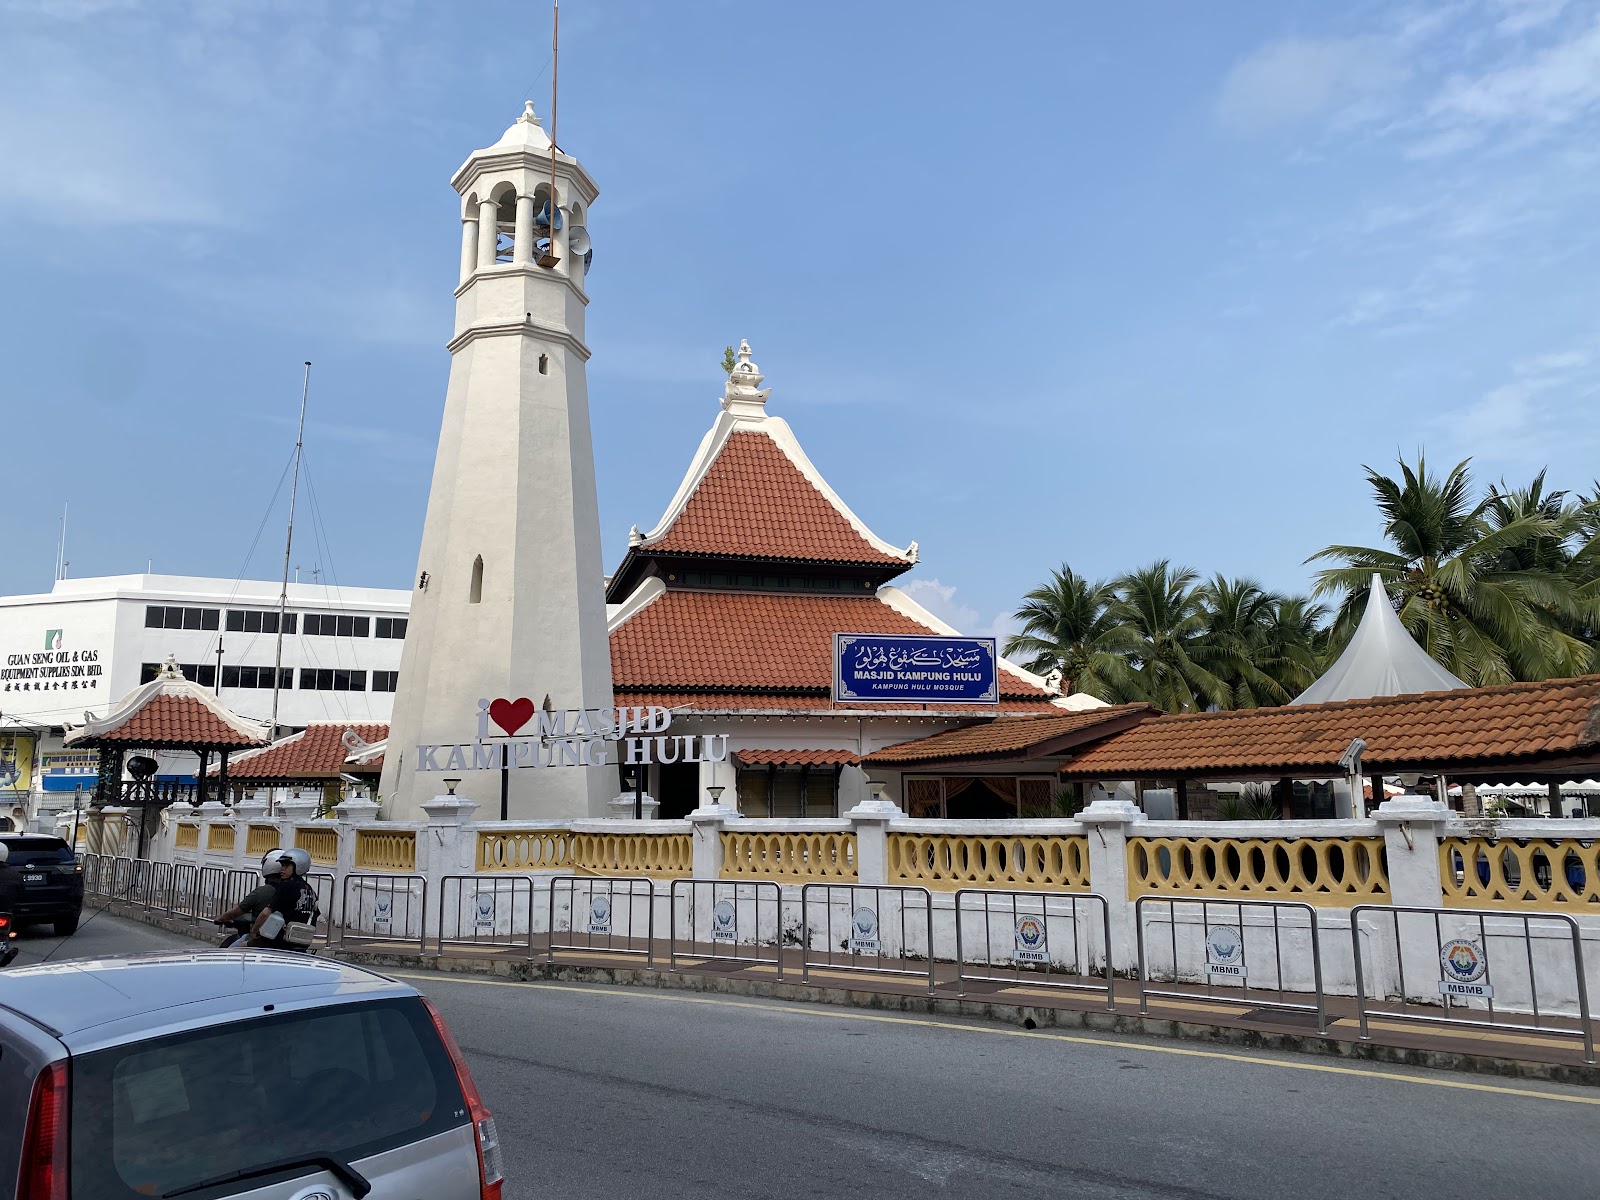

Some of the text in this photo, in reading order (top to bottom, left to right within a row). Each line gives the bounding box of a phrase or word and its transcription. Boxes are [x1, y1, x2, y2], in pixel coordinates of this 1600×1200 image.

[7, 650, 98, 666] GUAN SENG OIL & GAS
[0, 667, 39, 681] EQUIPMENT
[39, 666, 71, 678] SUPPLIES
[854, 670, 982, 681] MASJID KAMPUNG HULU
[534, 706, 672, 740] MASJID
[415, 734, 730, 771] KAMPUNG HULU
[1019, 952, 1043, 960] MBMB
[1211, 965, 1240, 975] MBMB
[1447, 984, 1484, 995] MBMB
